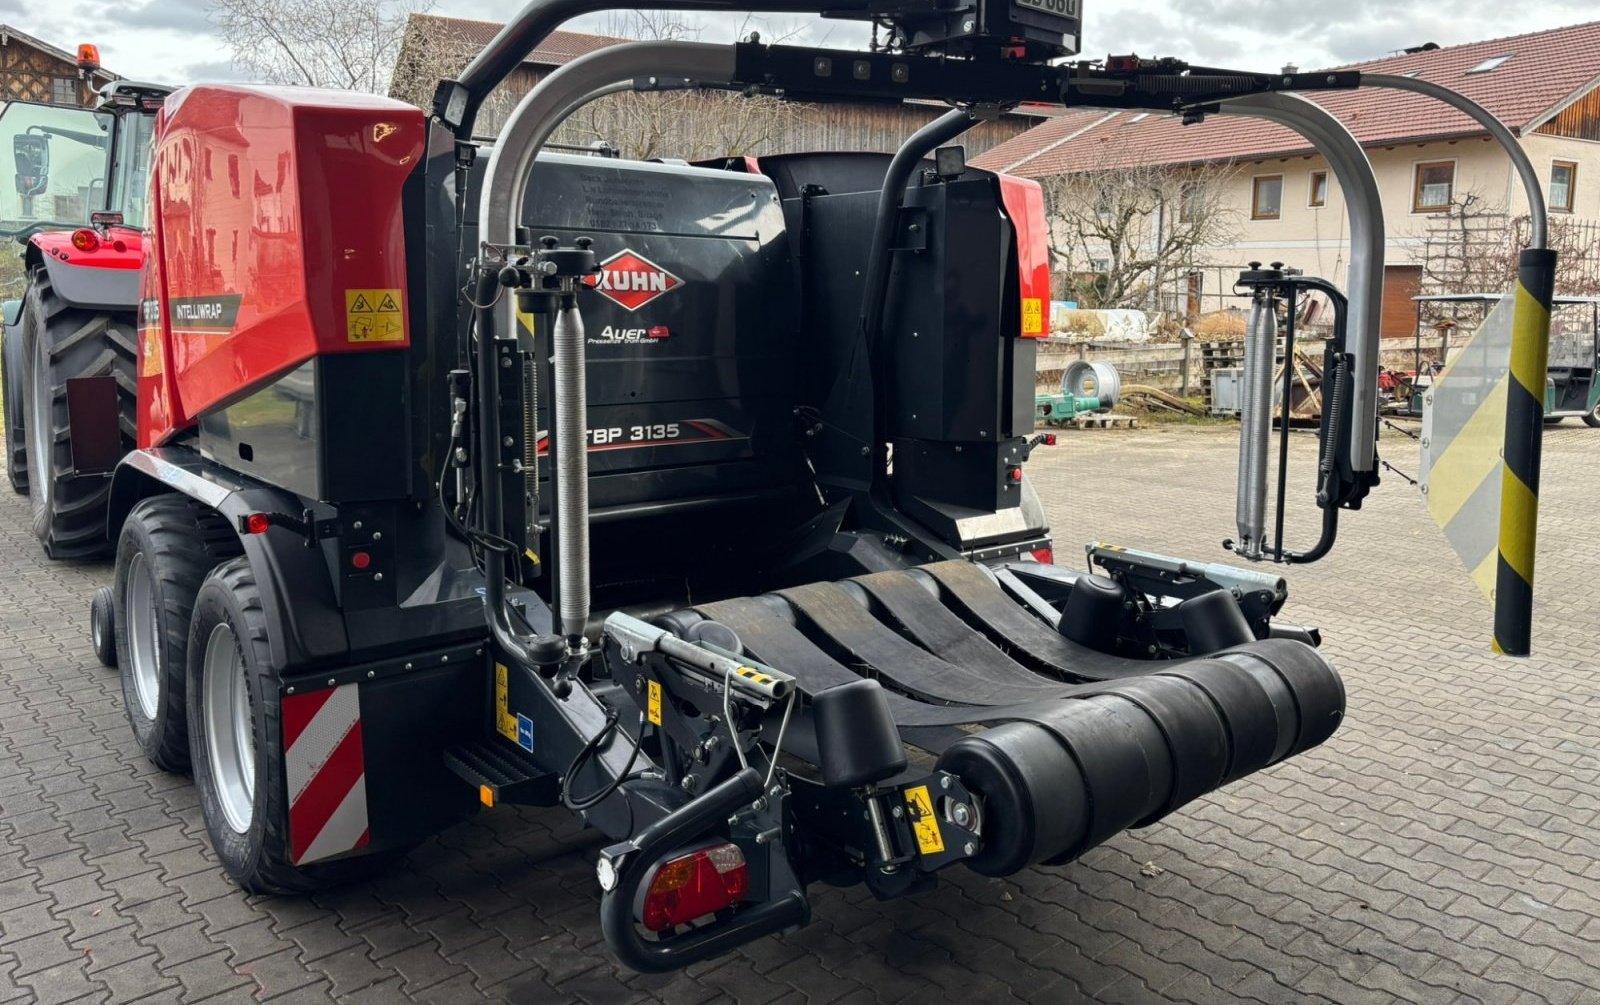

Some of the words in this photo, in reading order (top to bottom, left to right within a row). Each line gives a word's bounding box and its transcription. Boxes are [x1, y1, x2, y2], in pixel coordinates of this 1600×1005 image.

[595, 270, 667, 292] KUHN
[176, 303, 222, 320] INTELLIWRAP
[630, 423, 680, 441] 3135
